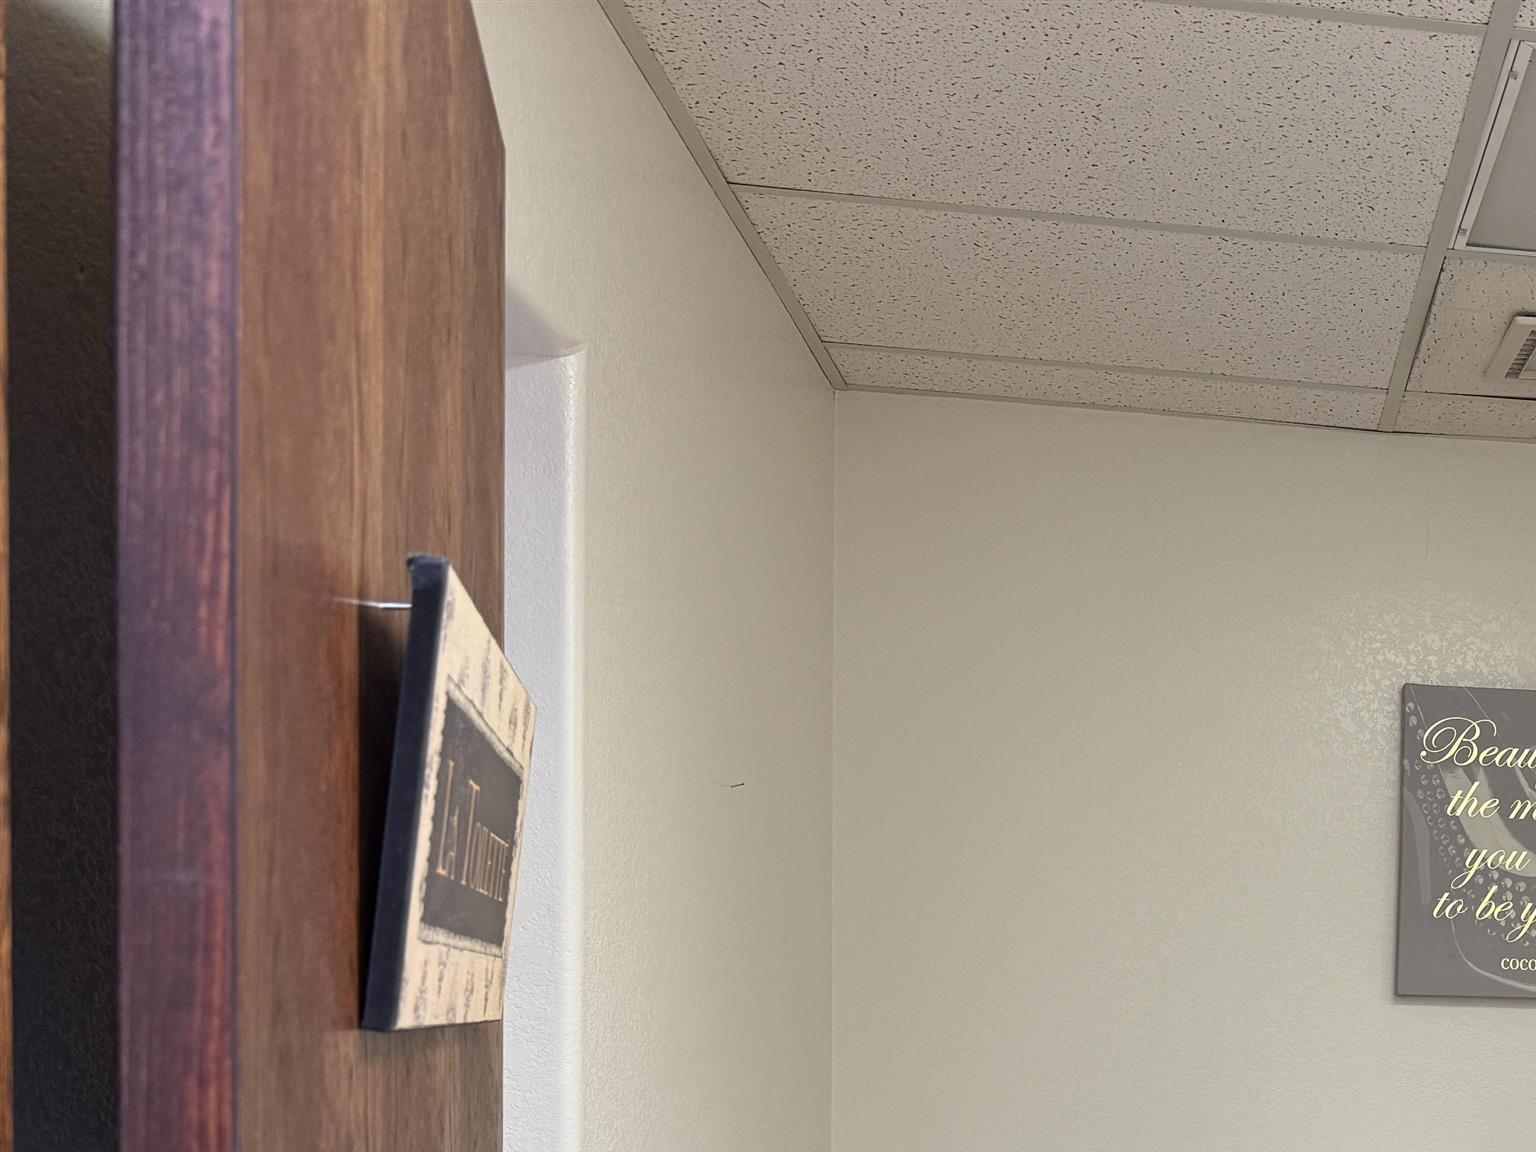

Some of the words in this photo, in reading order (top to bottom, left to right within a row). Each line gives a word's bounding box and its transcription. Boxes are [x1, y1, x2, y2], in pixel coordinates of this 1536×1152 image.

[1446, 781, 1501, 819] the
[1451, 847, 1532, 890] you
[1432, 892, 1468, 920] to
[1475, 885, 1515, 921] be
